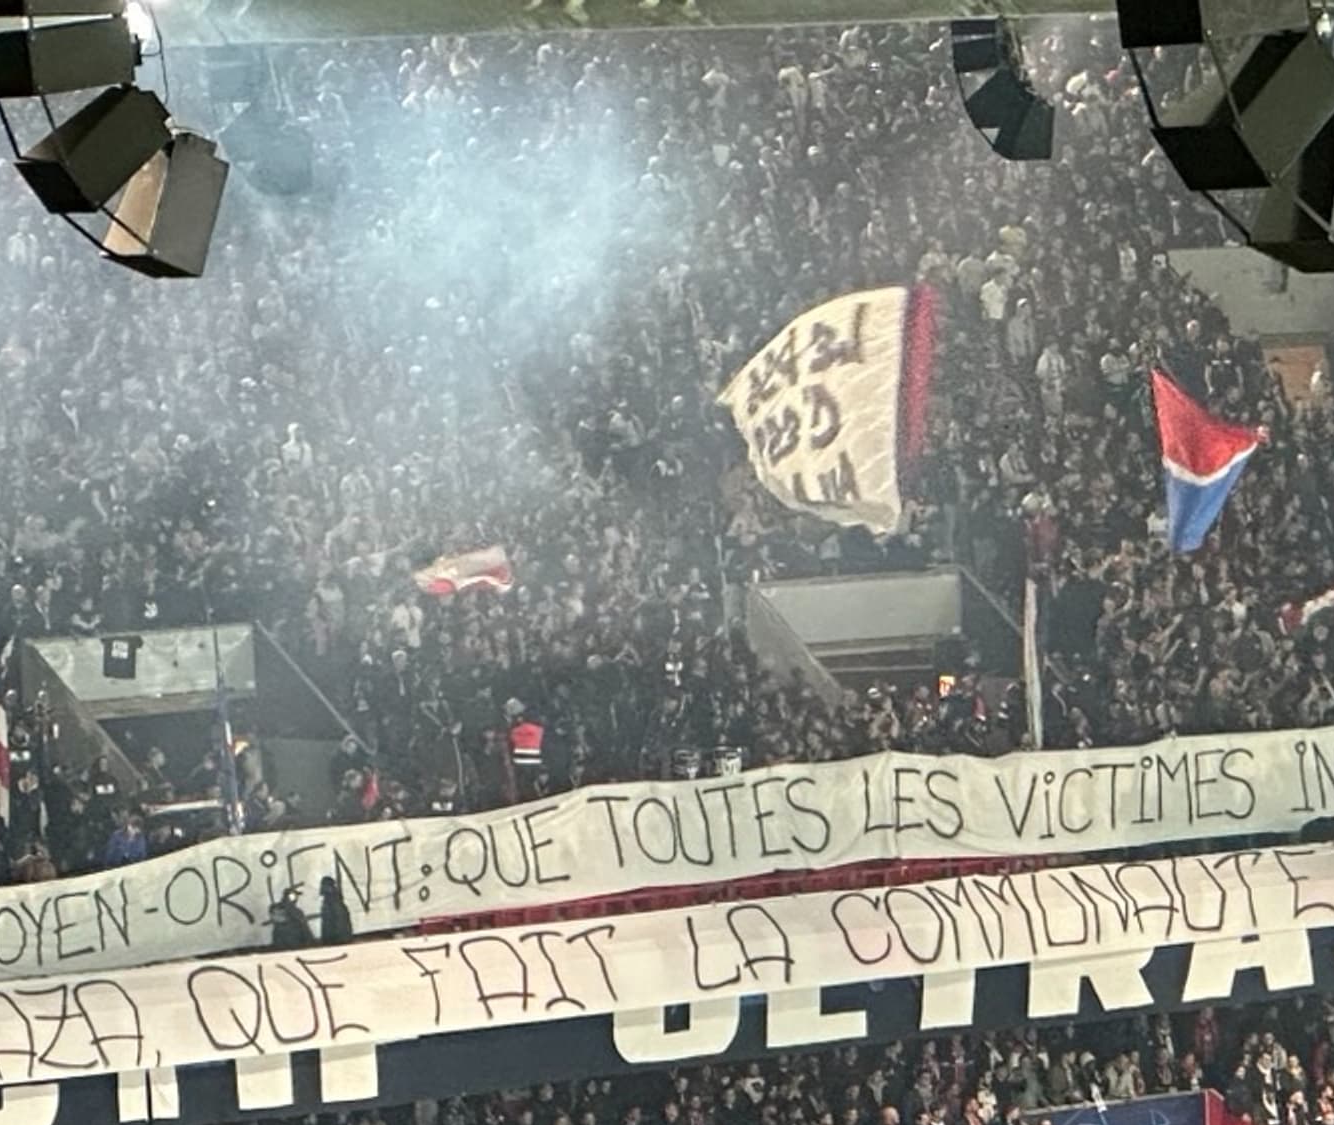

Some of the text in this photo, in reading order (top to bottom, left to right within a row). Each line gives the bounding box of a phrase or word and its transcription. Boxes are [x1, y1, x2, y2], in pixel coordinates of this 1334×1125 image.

[587, 776, 832, 868] TOUTES
[863, 767, 965, 839] LES
[187, 953, 371, 1055] QUE
[401, 924, 619, 1026] FAIT
[686, 903, 797, 990] LA
